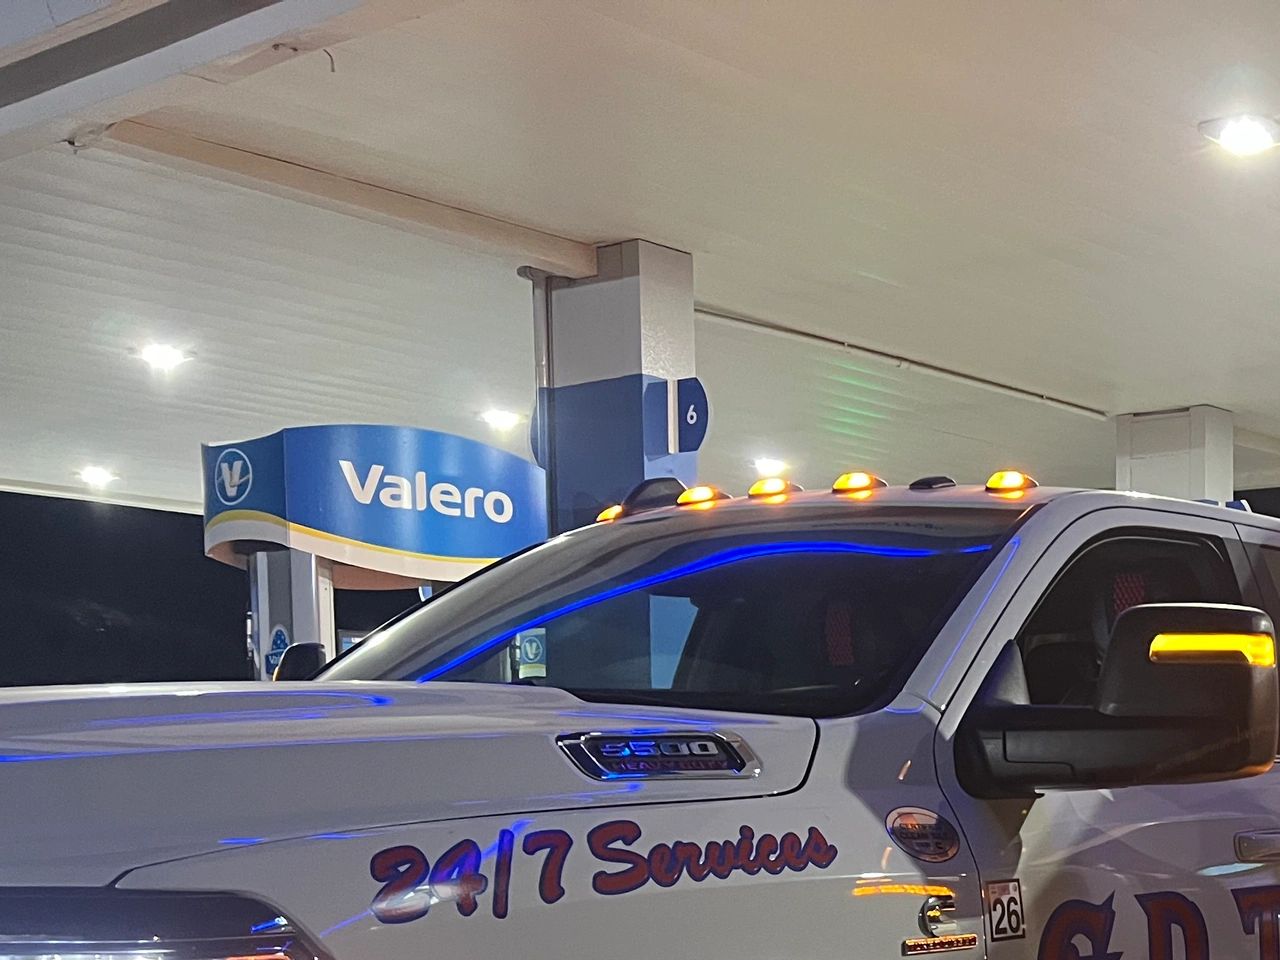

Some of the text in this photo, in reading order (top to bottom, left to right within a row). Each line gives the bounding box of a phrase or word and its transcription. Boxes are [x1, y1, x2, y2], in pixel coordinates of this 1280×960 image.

[686, 404, 698, 425] 6
[339, 460, 514, 523] Valero
[601, 741, 719, 757] 5500
[370, 820, 838, 924] 24/7 Services
[992, 896, 1021, 935] 26
